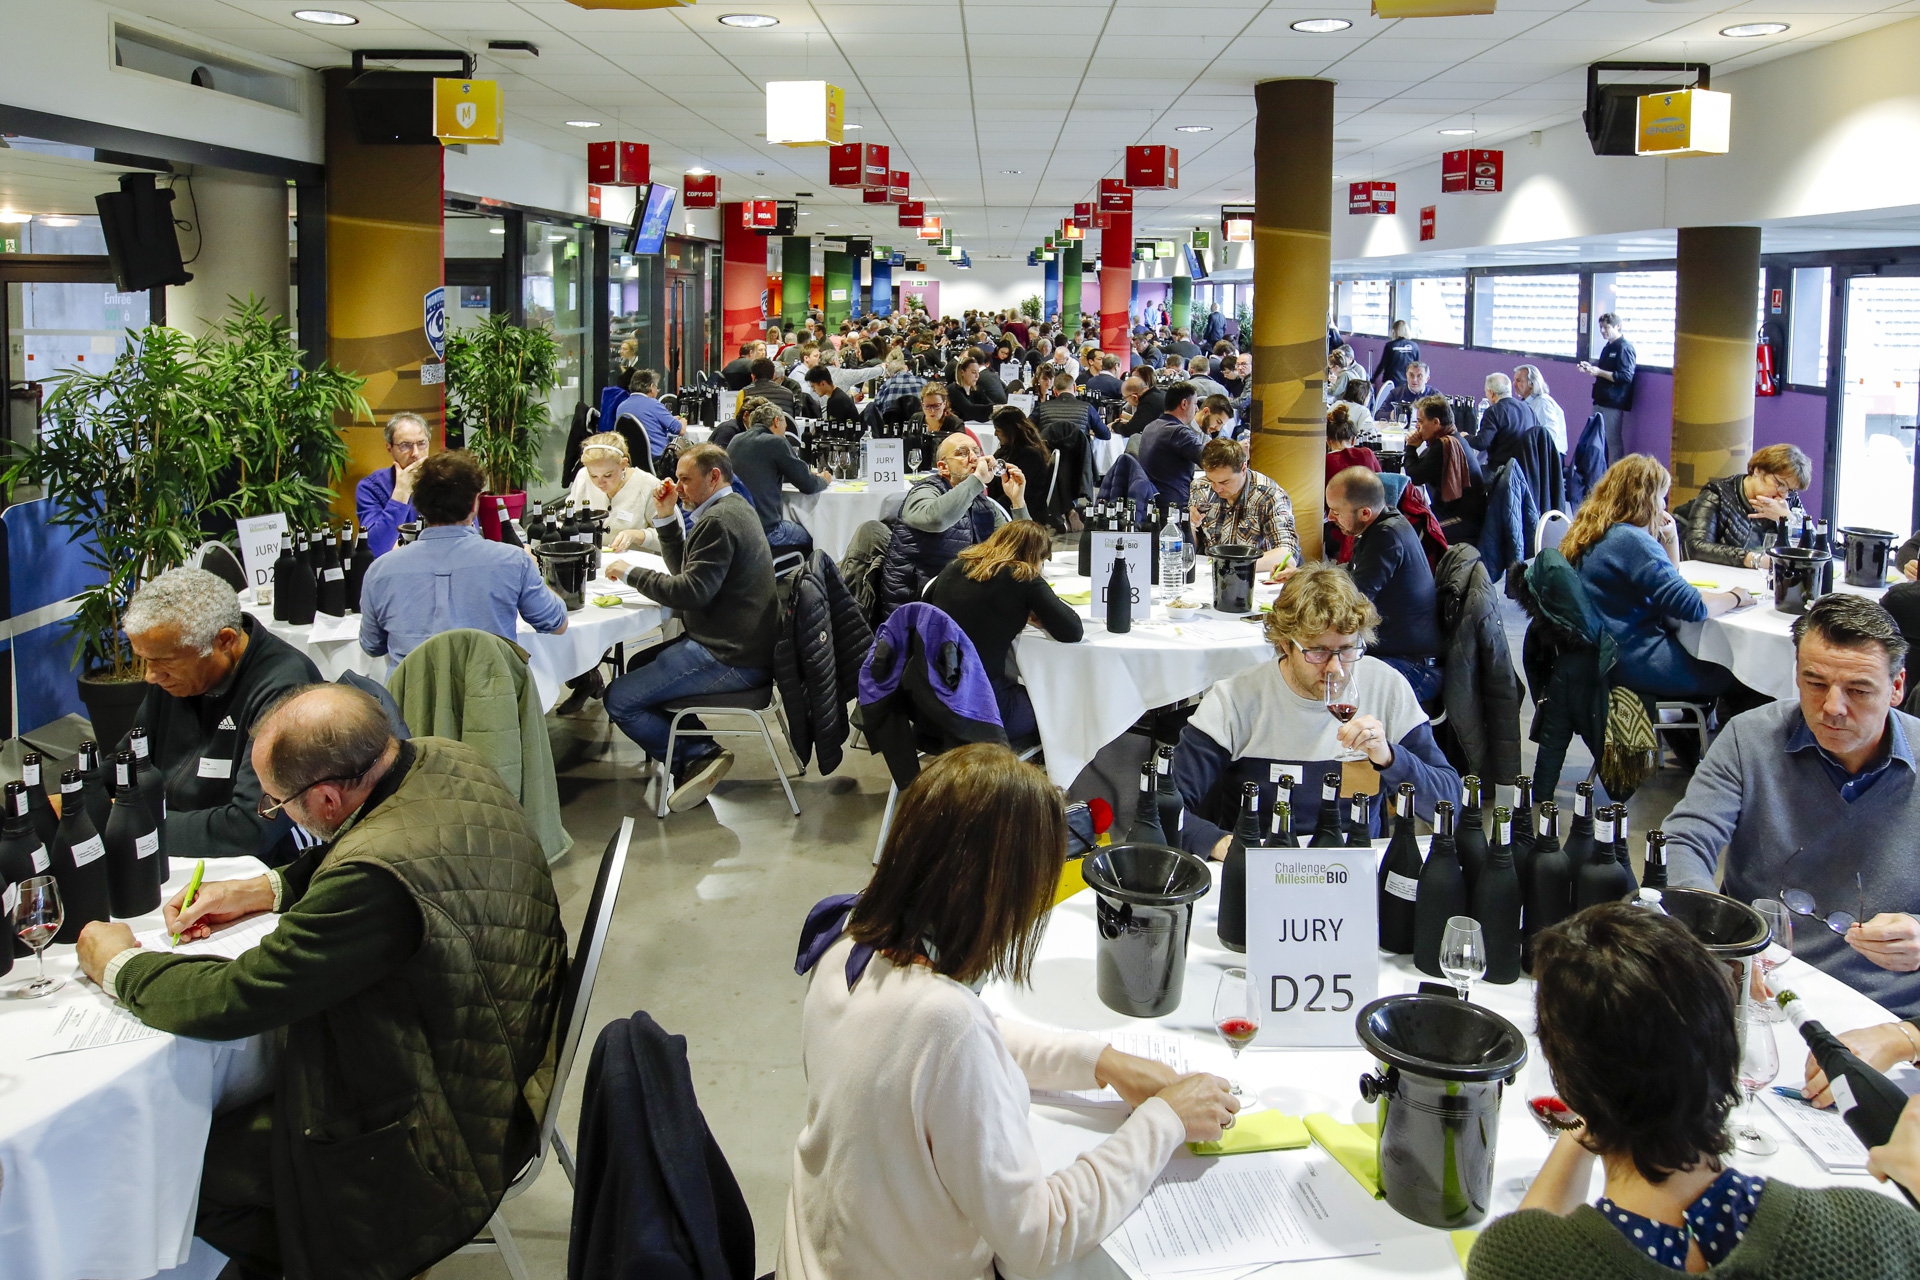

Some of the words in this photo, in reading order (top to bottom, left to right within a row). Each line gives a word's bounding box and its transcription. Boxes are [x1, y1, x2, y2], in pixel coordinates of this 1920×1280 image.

[104, 292, 131, 304] Entrée
[874, 471, 897, 482] D31
[256, 542, 278, 556] JURY
[256, 567, 275, 585] D2
[1275, 862, 1326, 875] Challenge
[1275, 873, 1325, 884] Millésime
[1326, 872, 1347, 884] BIO
[1279, 918, 1343, 942] JURY
[1271, 974, 1354, 1012] D25
